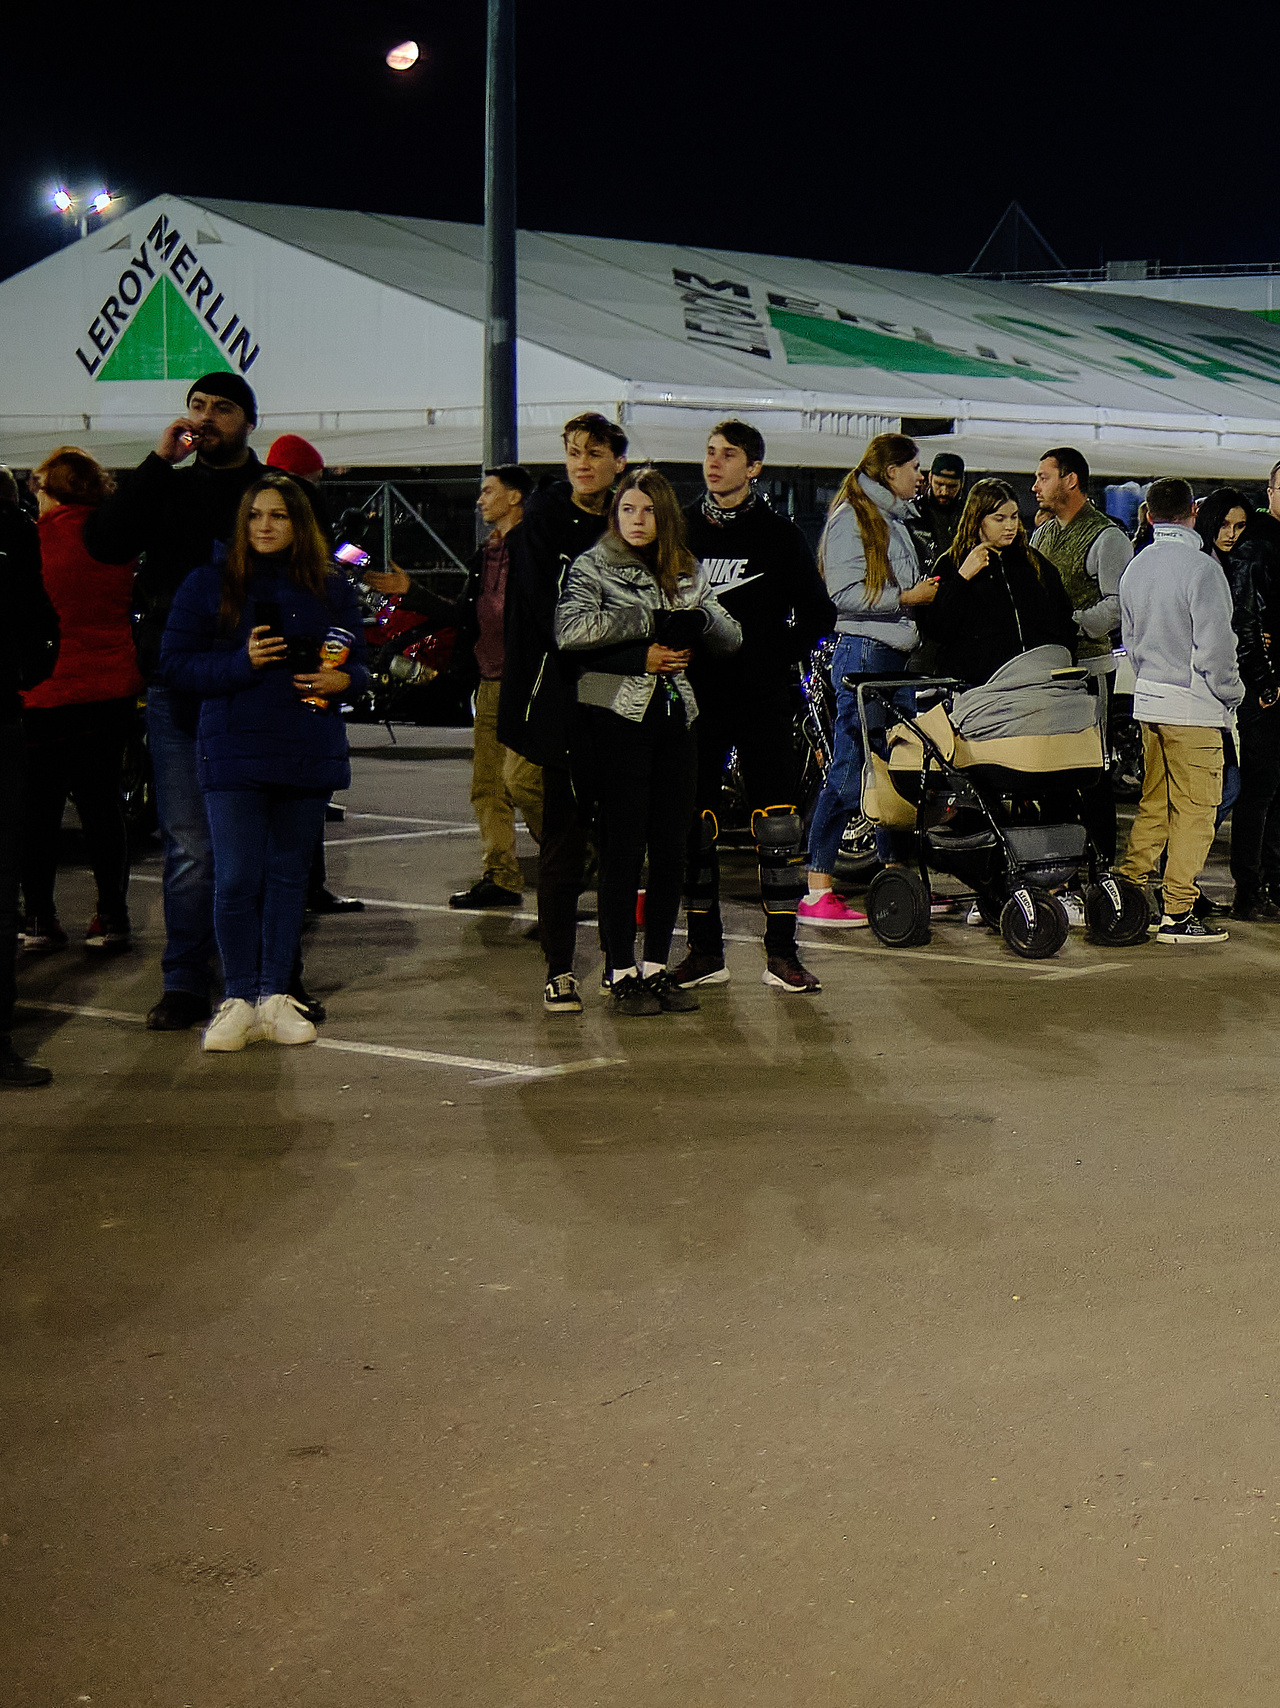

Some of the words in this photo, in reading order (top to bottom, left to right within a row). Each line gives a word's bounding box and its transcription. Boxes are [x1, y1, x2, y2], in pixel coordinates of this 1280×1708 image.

[75, 241, 156, 376] LEROY
[146, 213, 261, 374] MERLIN
[702, 558, 749, 583] NIKE
